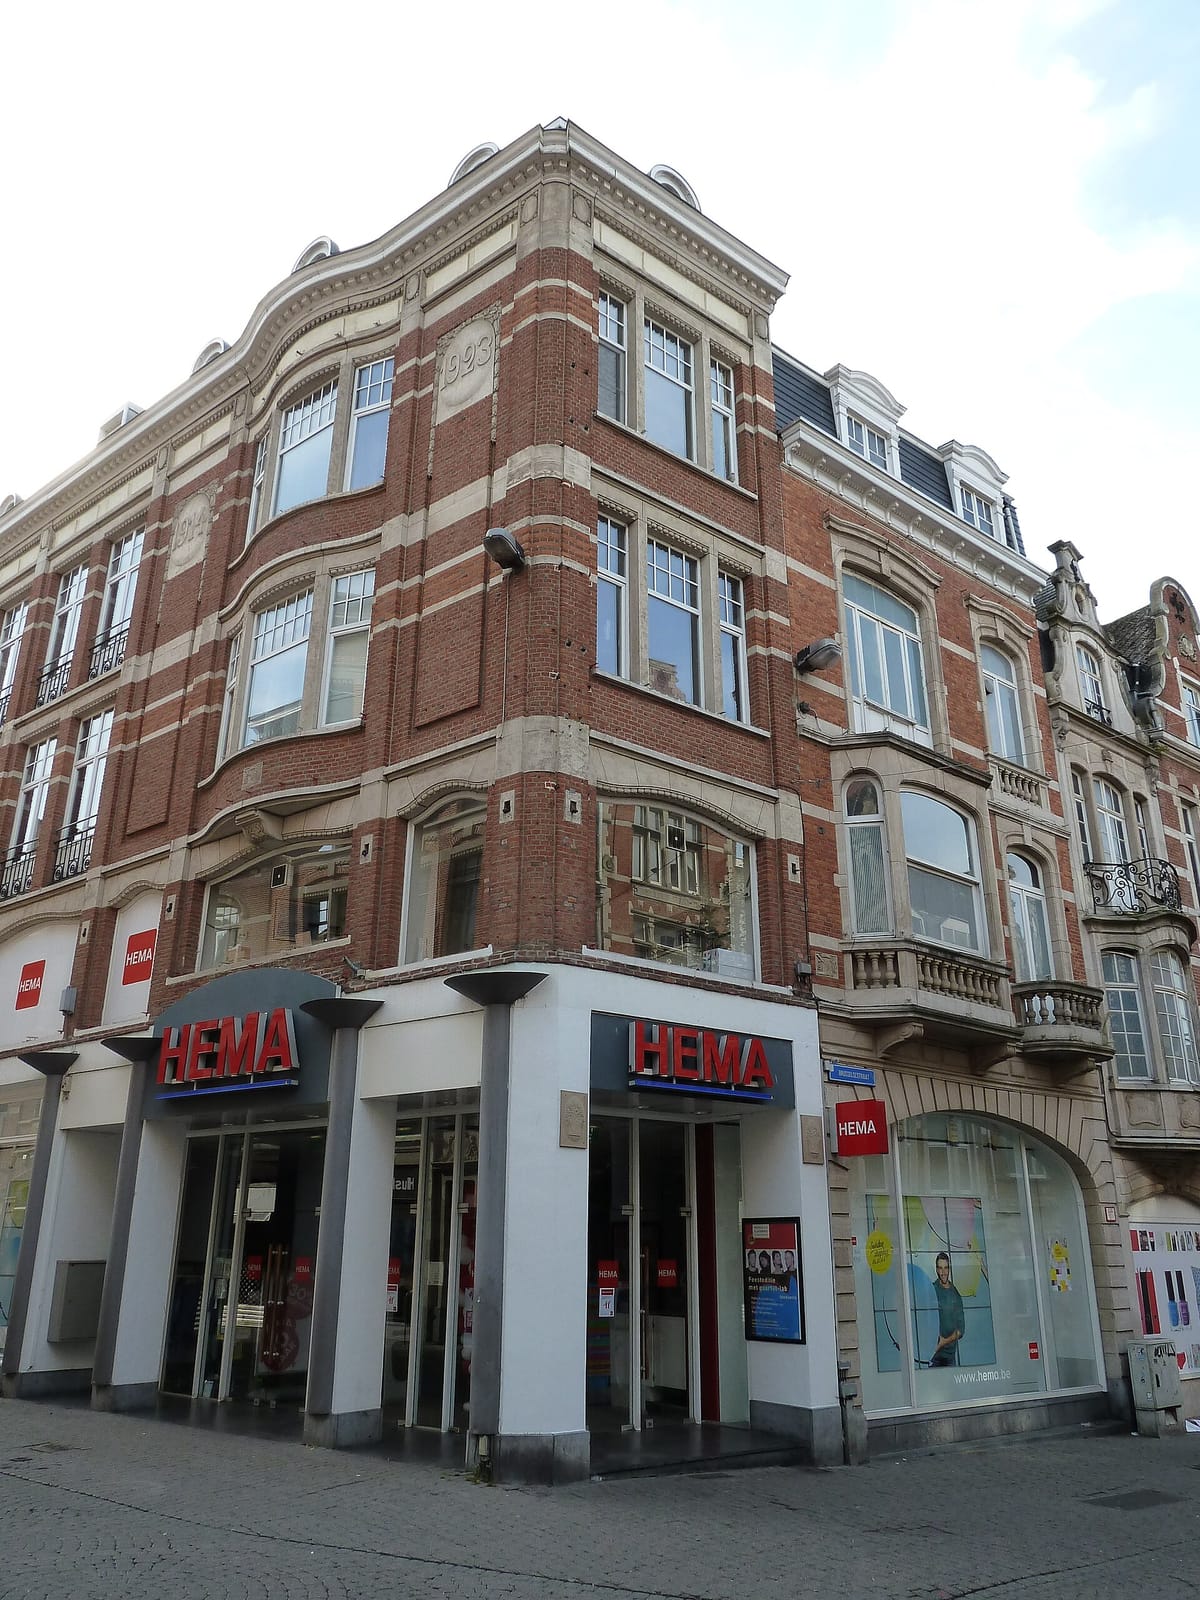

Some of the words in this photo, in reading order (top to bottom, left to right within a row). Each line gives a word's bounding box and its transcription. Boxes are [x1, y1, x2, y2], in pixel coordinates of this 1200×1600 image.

[439, 336, 494, 392] 1923
[125, 948, 153, 967] HEMA
[18, 976, 41, 993] HEMA
[156, 1007, 297, 1084] HEMA
[629, 1018, 774, 1088] HEMA
[839, 1120, 877, 1136] HEMA
[295, 1265, 310, 1273] HEMA
[598, 1270, 618, 1279] HEMA
[658, 1269, 676, 1278] HEMA
[953, 1368, 1011, 1385] www.hema.be
